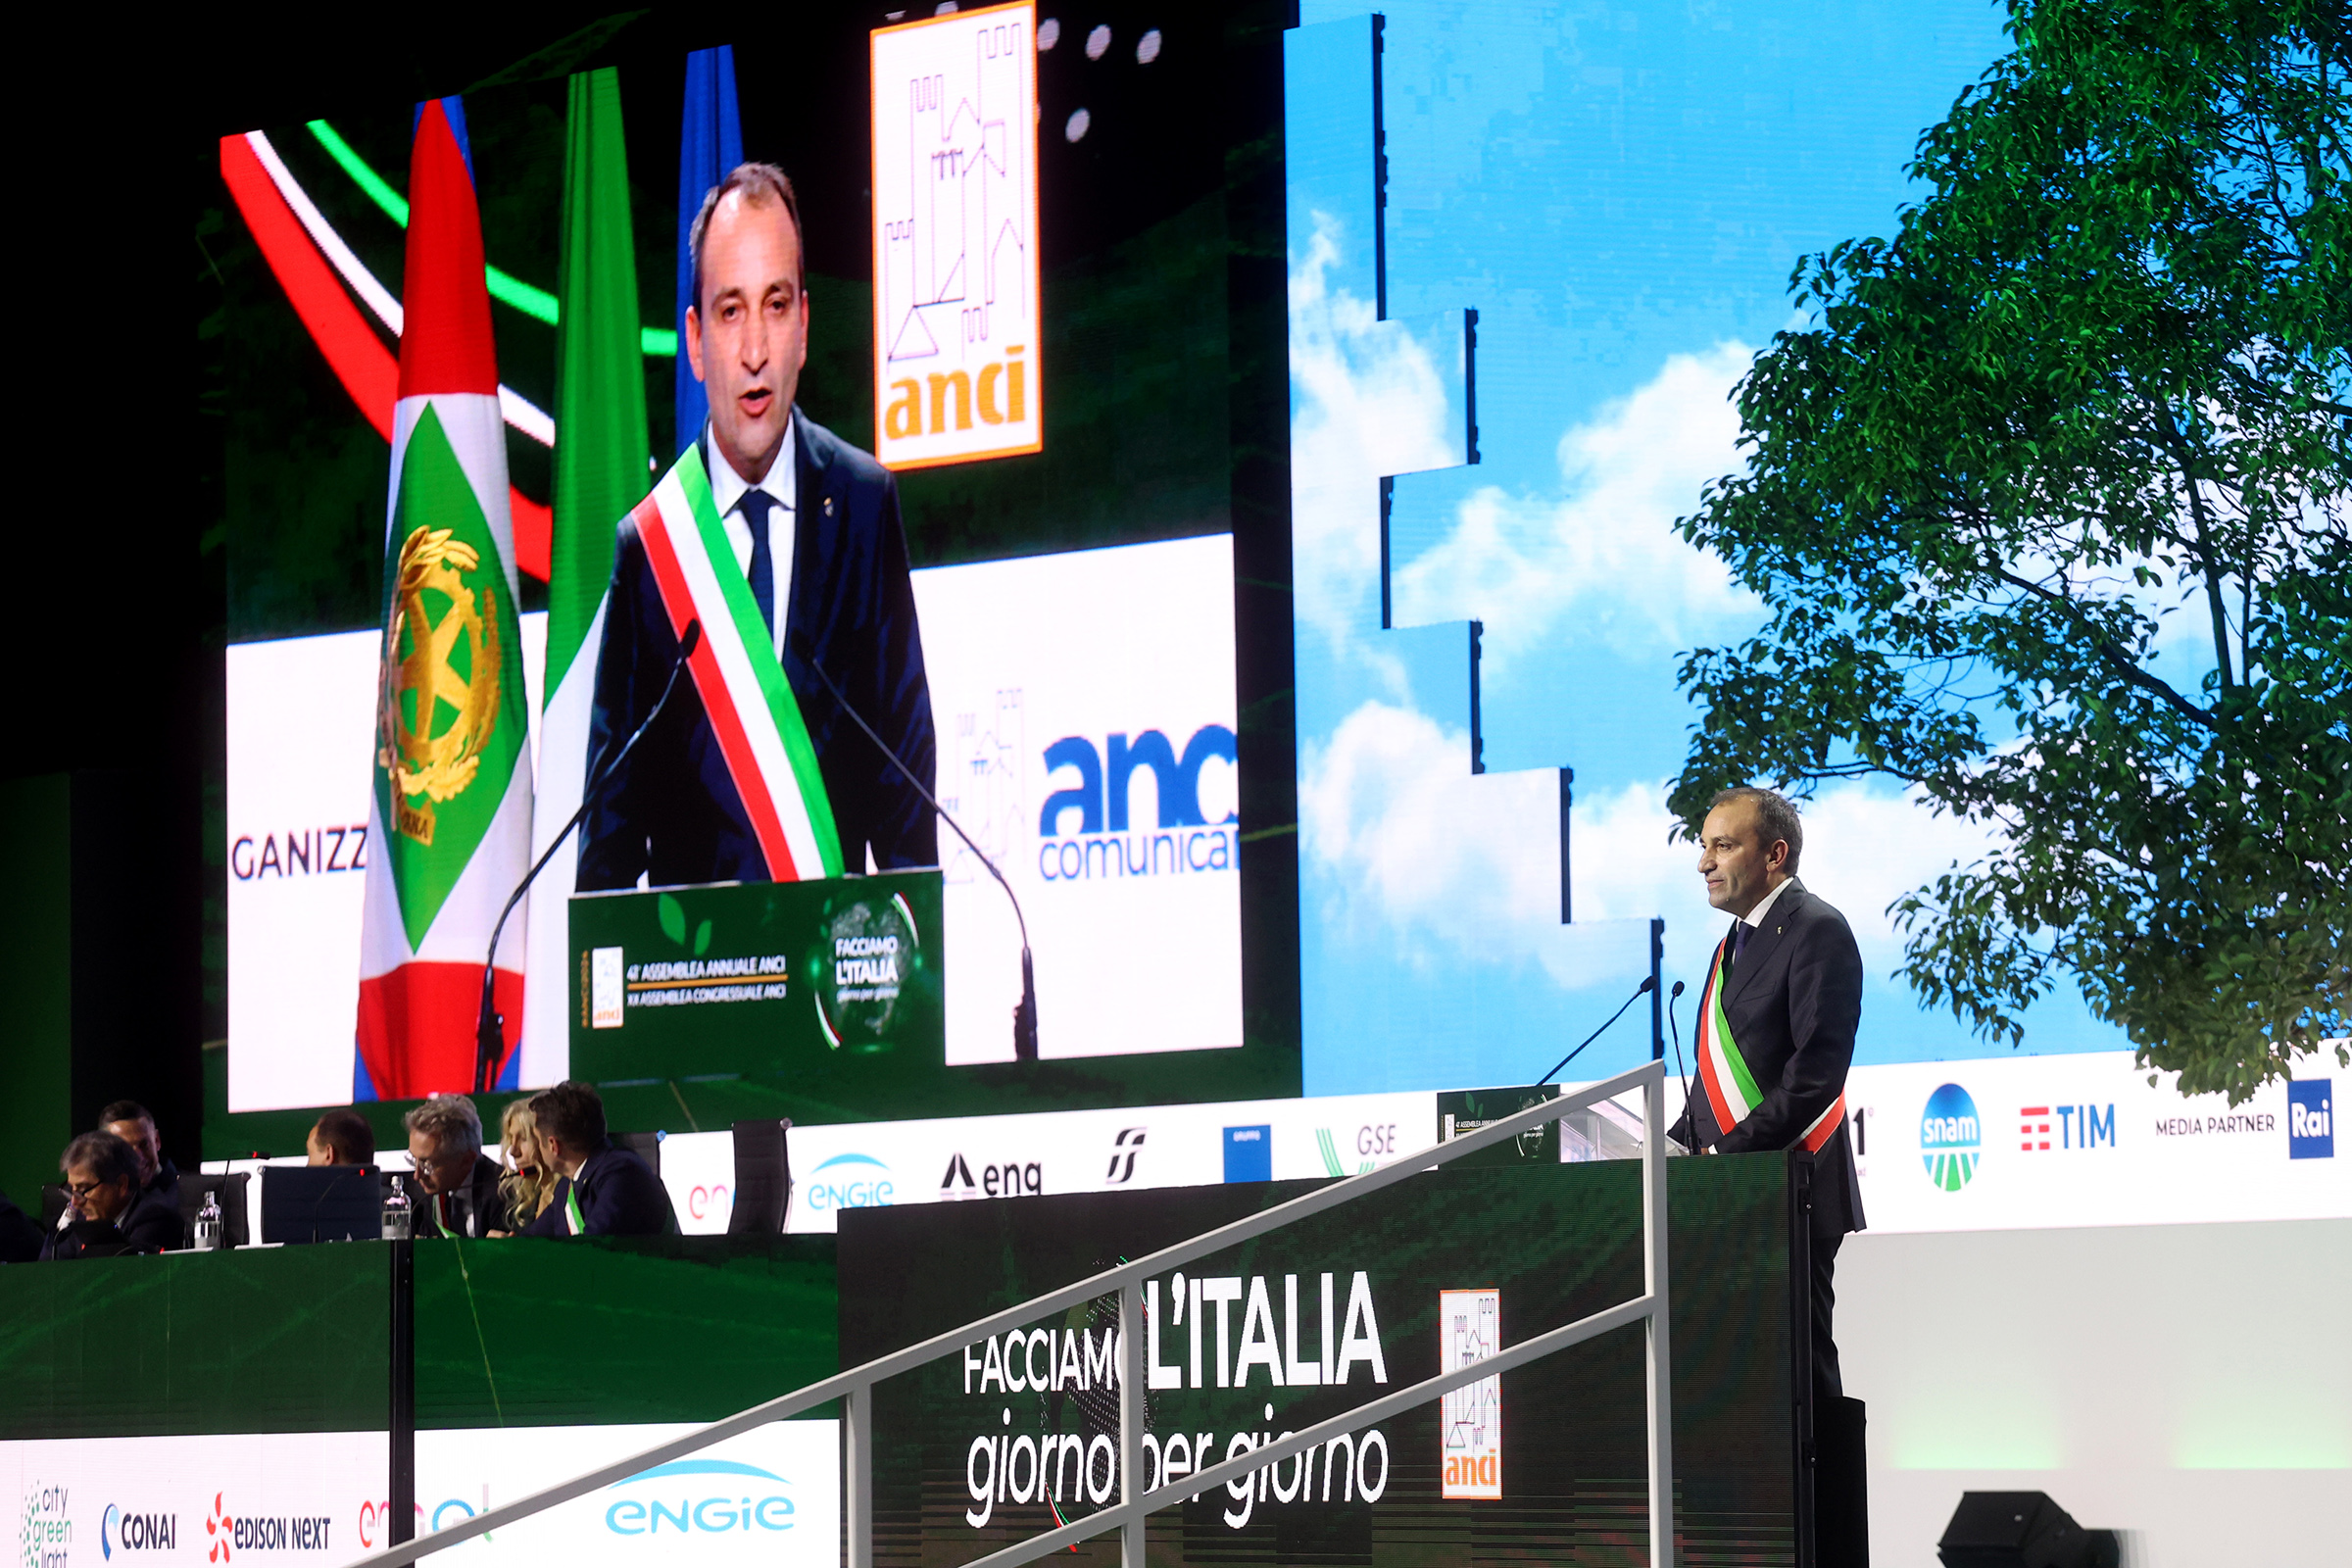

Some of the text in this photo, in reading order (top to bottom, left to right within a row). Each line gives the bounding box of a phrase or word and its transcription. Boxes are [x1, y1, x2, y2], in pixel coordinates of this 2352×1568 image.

[884, 344, 1026, 441] anci
[835, 934, 899, 957] FACCIAMO
[1923, 1113, 1979, 1145] snam
[2056, 1102, 2116, 1150] TIM
[2156, 1113, 2276, 1137] MEDIA PARTNER
[2290, 1098, 2330, 1139] Rai
[1357, 1124, 1396, 1155] GSE
[1147, 1270, 1389, 1390] L'ITALIA
[965, 1406, 1116, 1529] giorno
[1222, 1402, 1391, 1530] giorno
[1446, 1446, 1497, 1487] anci
[42, 1483, 70, 1519] city
[32, 1519, 73, 1551] green
[122, 1512, 177, 1550] CONAI
